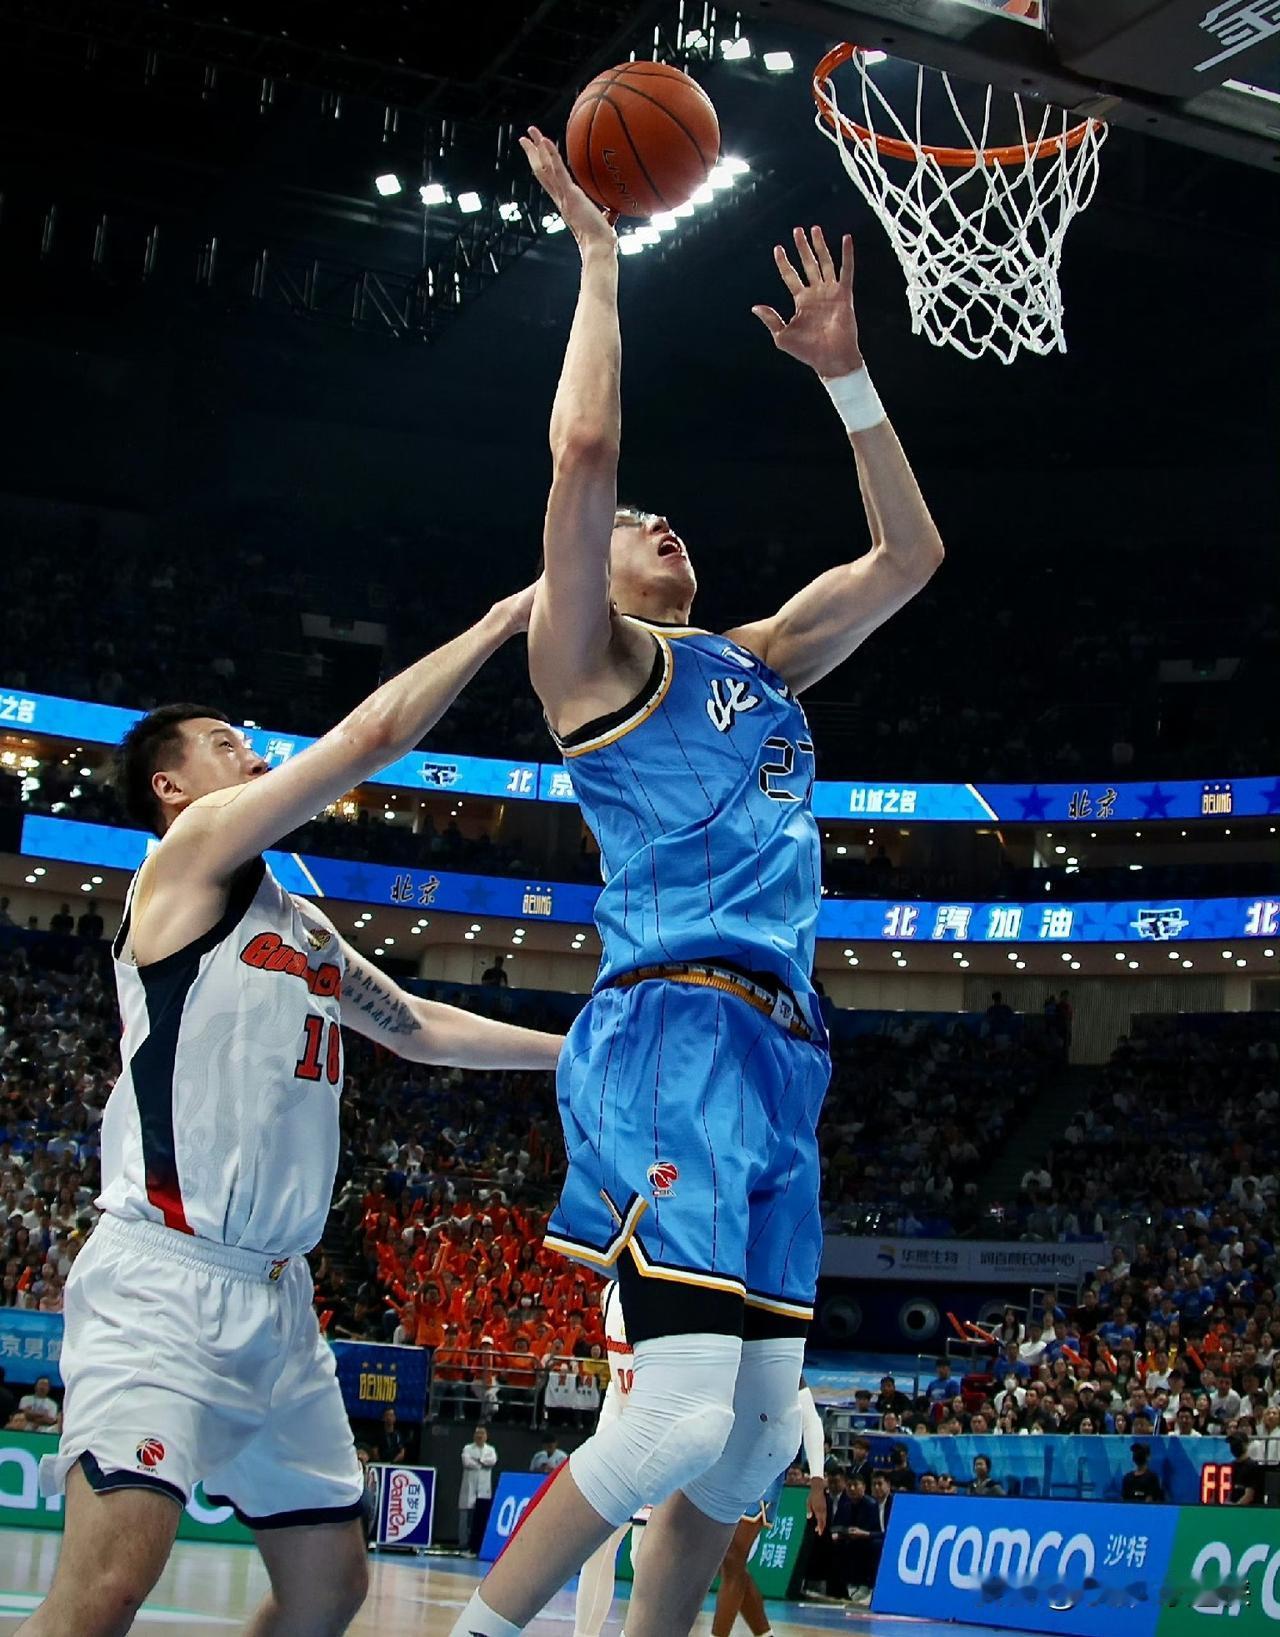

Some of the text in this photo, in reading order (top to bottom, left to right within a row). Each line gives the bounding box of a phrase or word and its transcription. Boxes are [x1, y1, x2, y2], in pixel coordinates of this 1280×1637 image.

[0, 696, 36, 723] 之名
[850, 788, 917, 813] 以城之名
[1068, 788, 1117, 819] 北京
[391, 874, 440, 905] 北京
[359, 1373, 397, 1402] BEIJING
[760, 1543, 787, 1568] 阿美
[1104, 1534, 1148, 1568] 沙特
